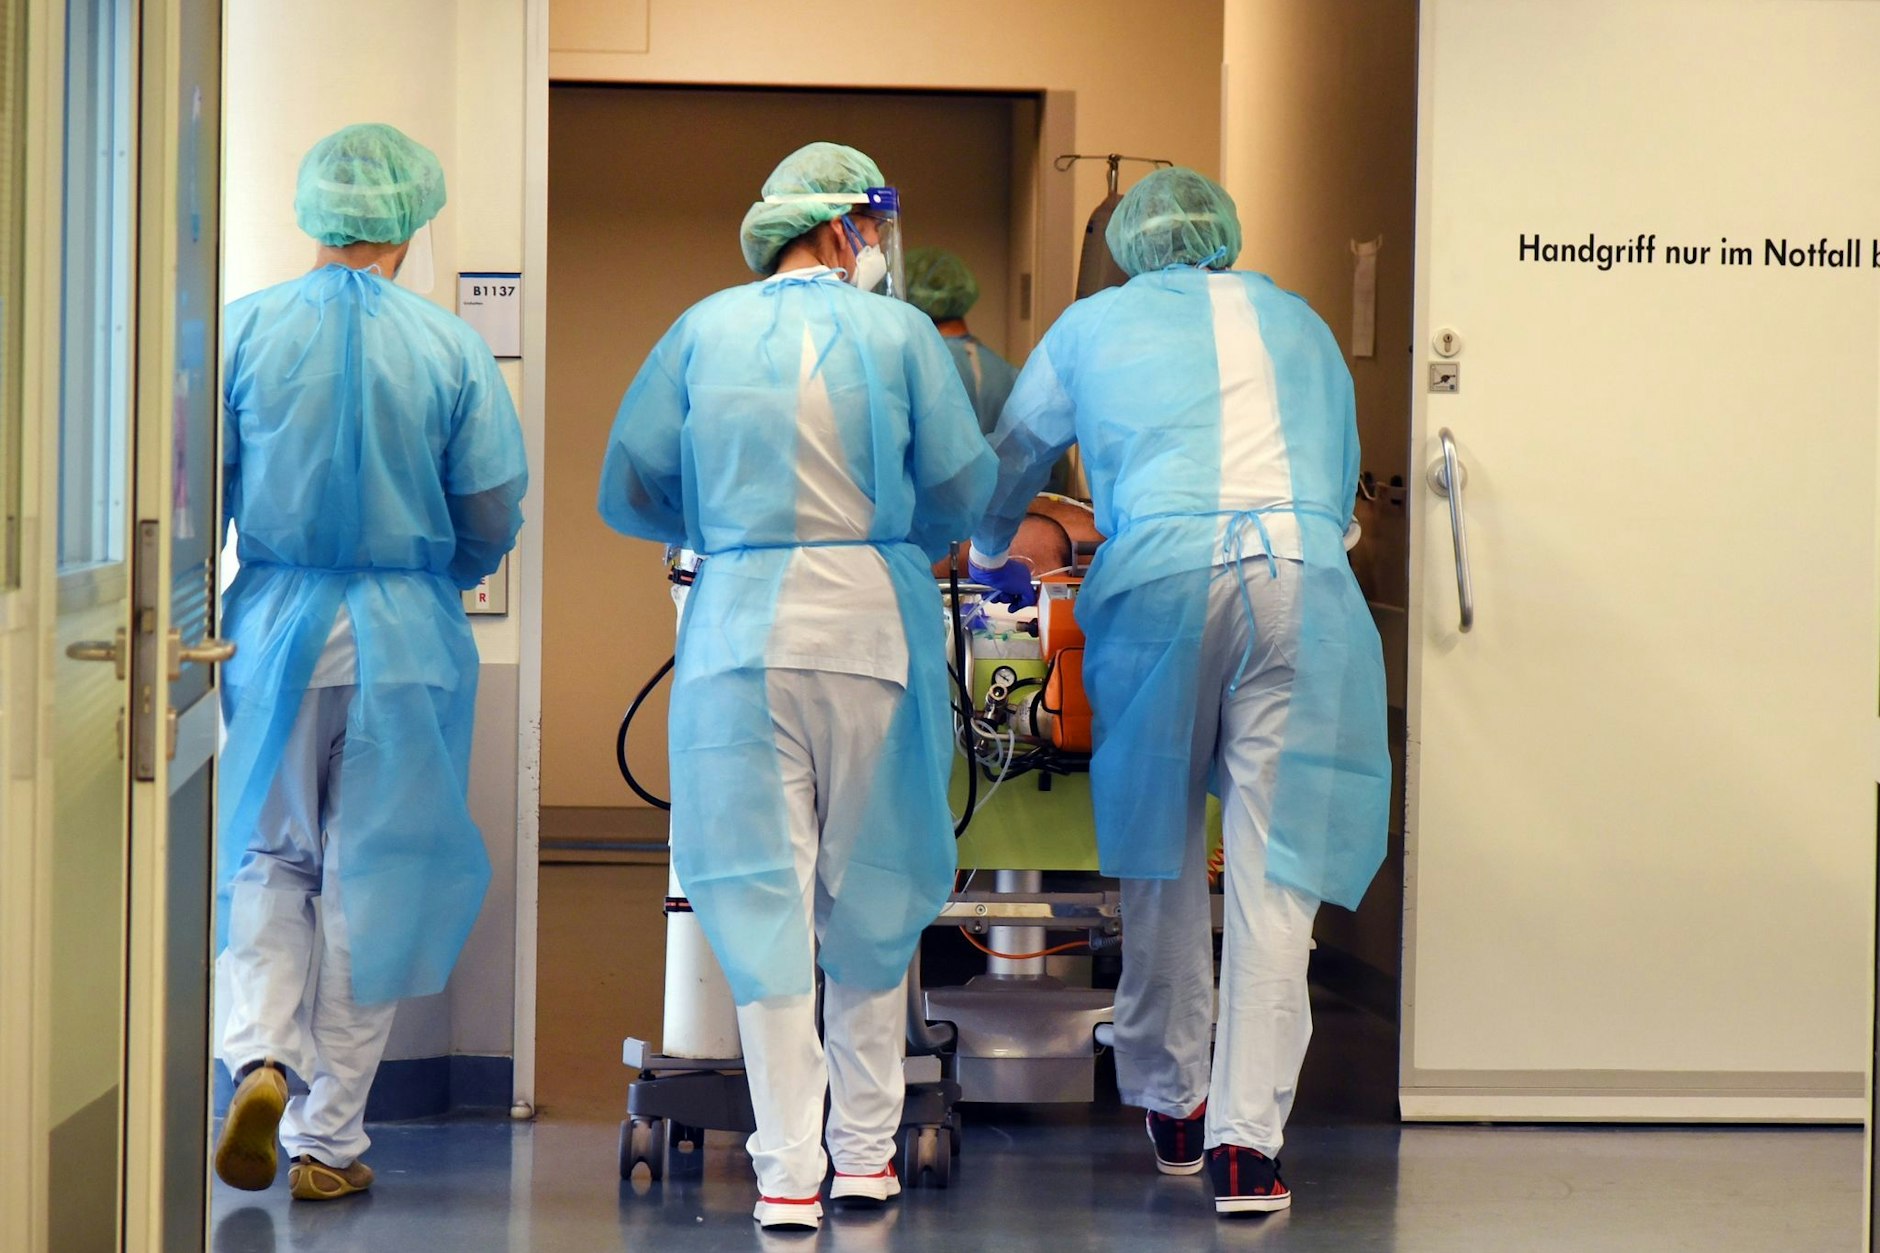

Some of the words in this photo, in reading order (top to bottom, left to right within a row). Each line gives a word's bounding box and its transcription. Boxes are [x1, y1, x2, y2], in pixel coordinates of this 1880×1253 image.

[1519, 233, 1656, 271] Handgriff
[1665, 246, 1711, 264] nur
[1721, 237, 1752, 265] im
[1764, 237, 1861, 267] Notfall
[473, 286, 515, 297] B1137
